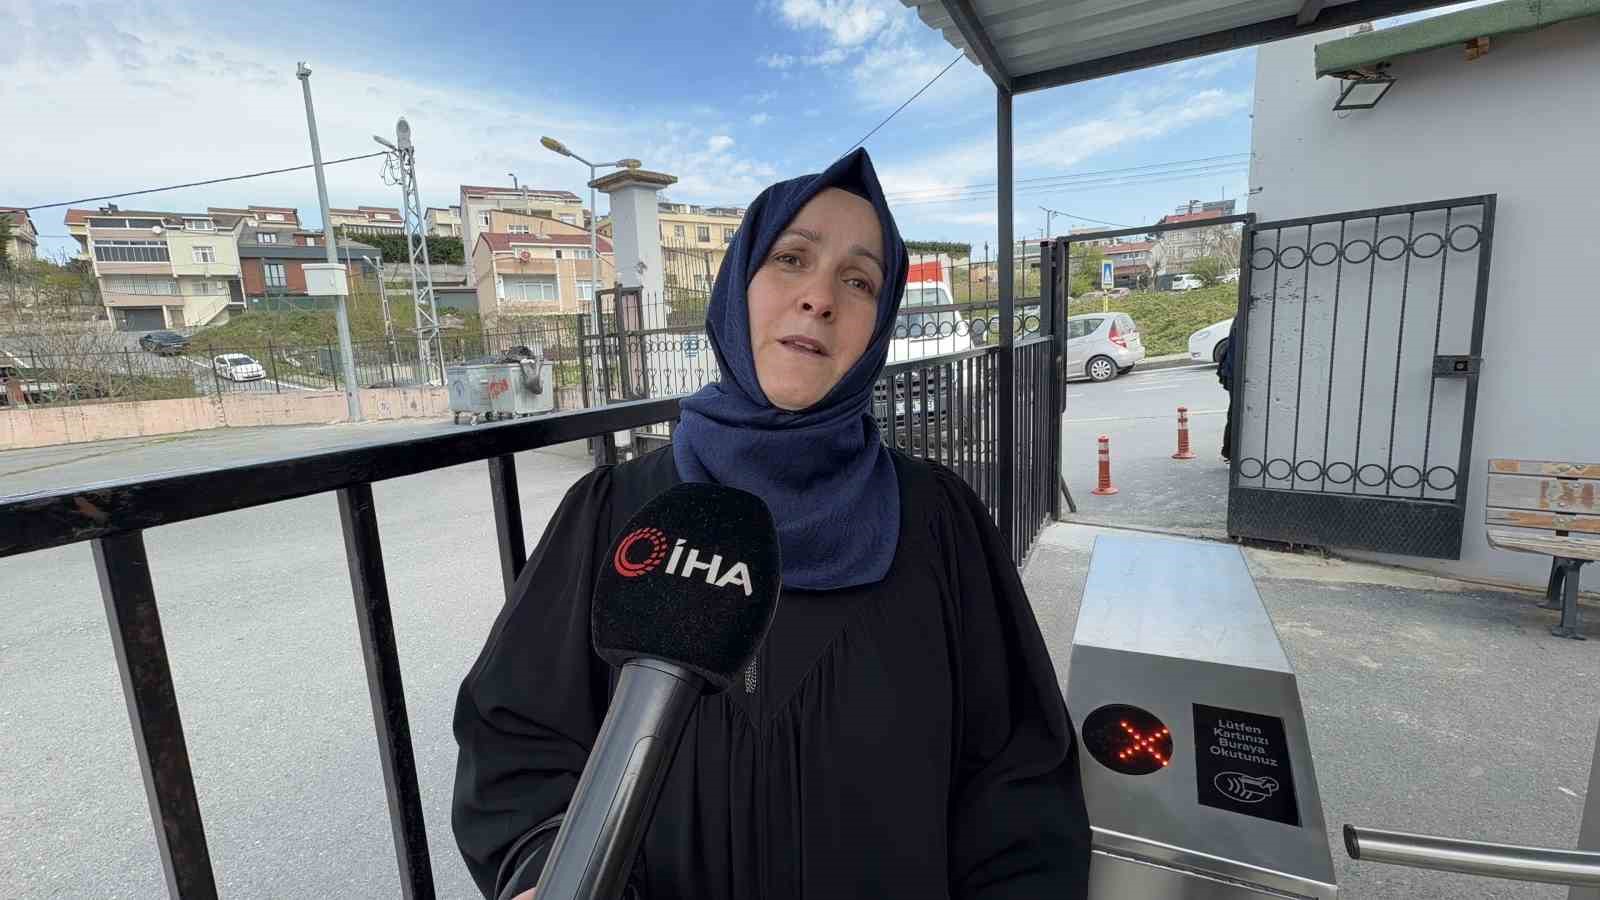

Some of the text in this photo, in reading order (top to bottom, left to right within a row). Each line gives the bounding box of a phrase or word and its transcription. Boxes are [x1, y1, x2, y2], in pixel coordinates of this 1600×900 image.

[665, 538, 753, 597] İHA
[1218, 719, 1261, 734] Lütfen
[1213, 728, 1269, 745] Kartınızı
[1219, 737, 1266, 754] Buraya
[1209, 746, 1279, 767] Okutunuz
